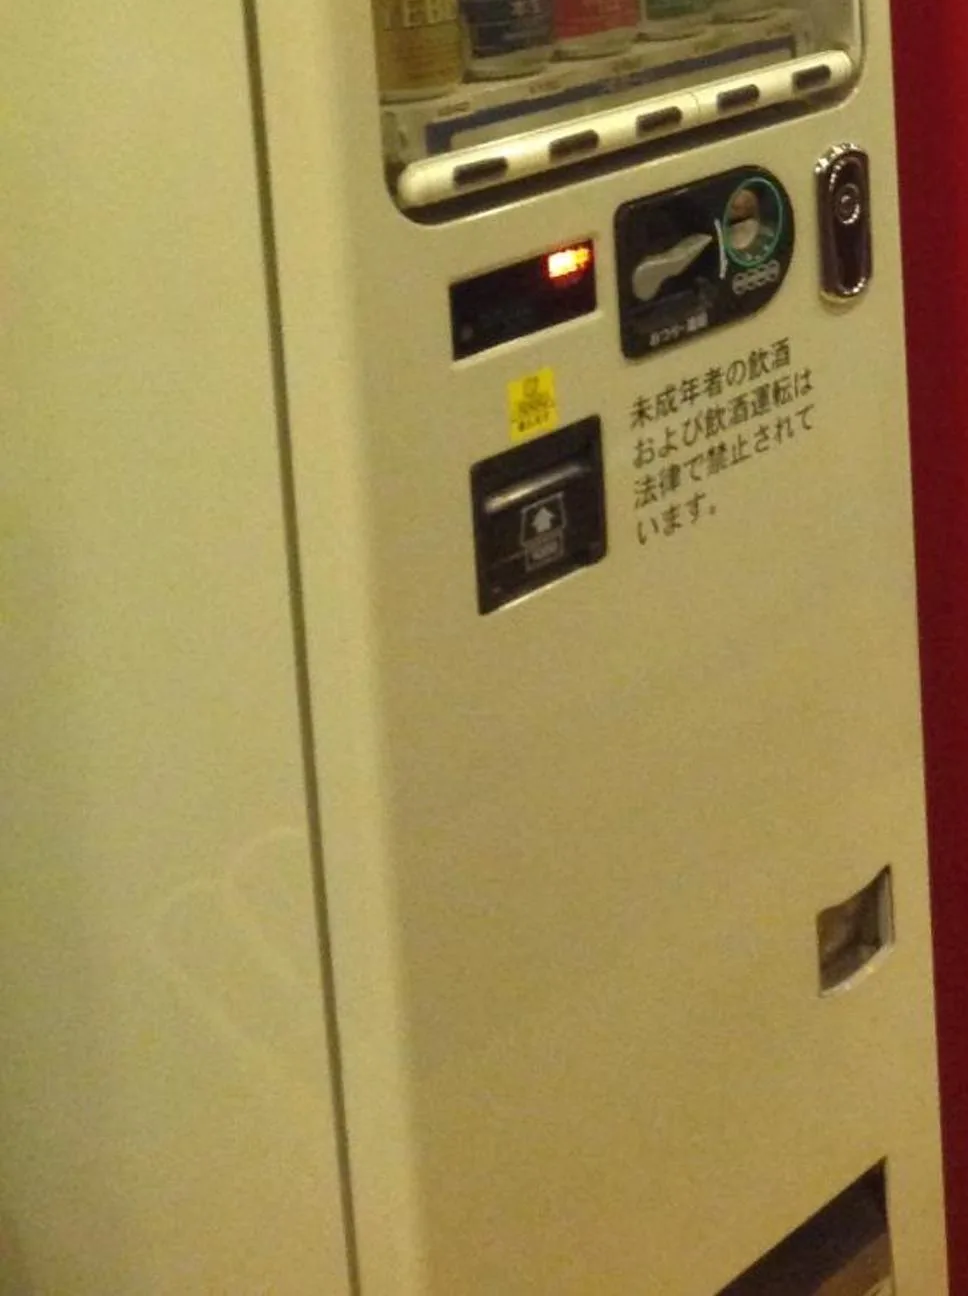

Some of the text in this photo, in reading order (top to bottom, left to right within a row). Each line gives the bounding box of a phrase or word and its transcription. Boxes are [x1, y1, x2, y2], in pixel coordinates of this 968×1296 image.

[630, 336, 791, 429] 未成年者の飲酒
[633, 367, 814, 469] および飲酒運転は
[634, 404, 815, 510] 法律で禁止されて
